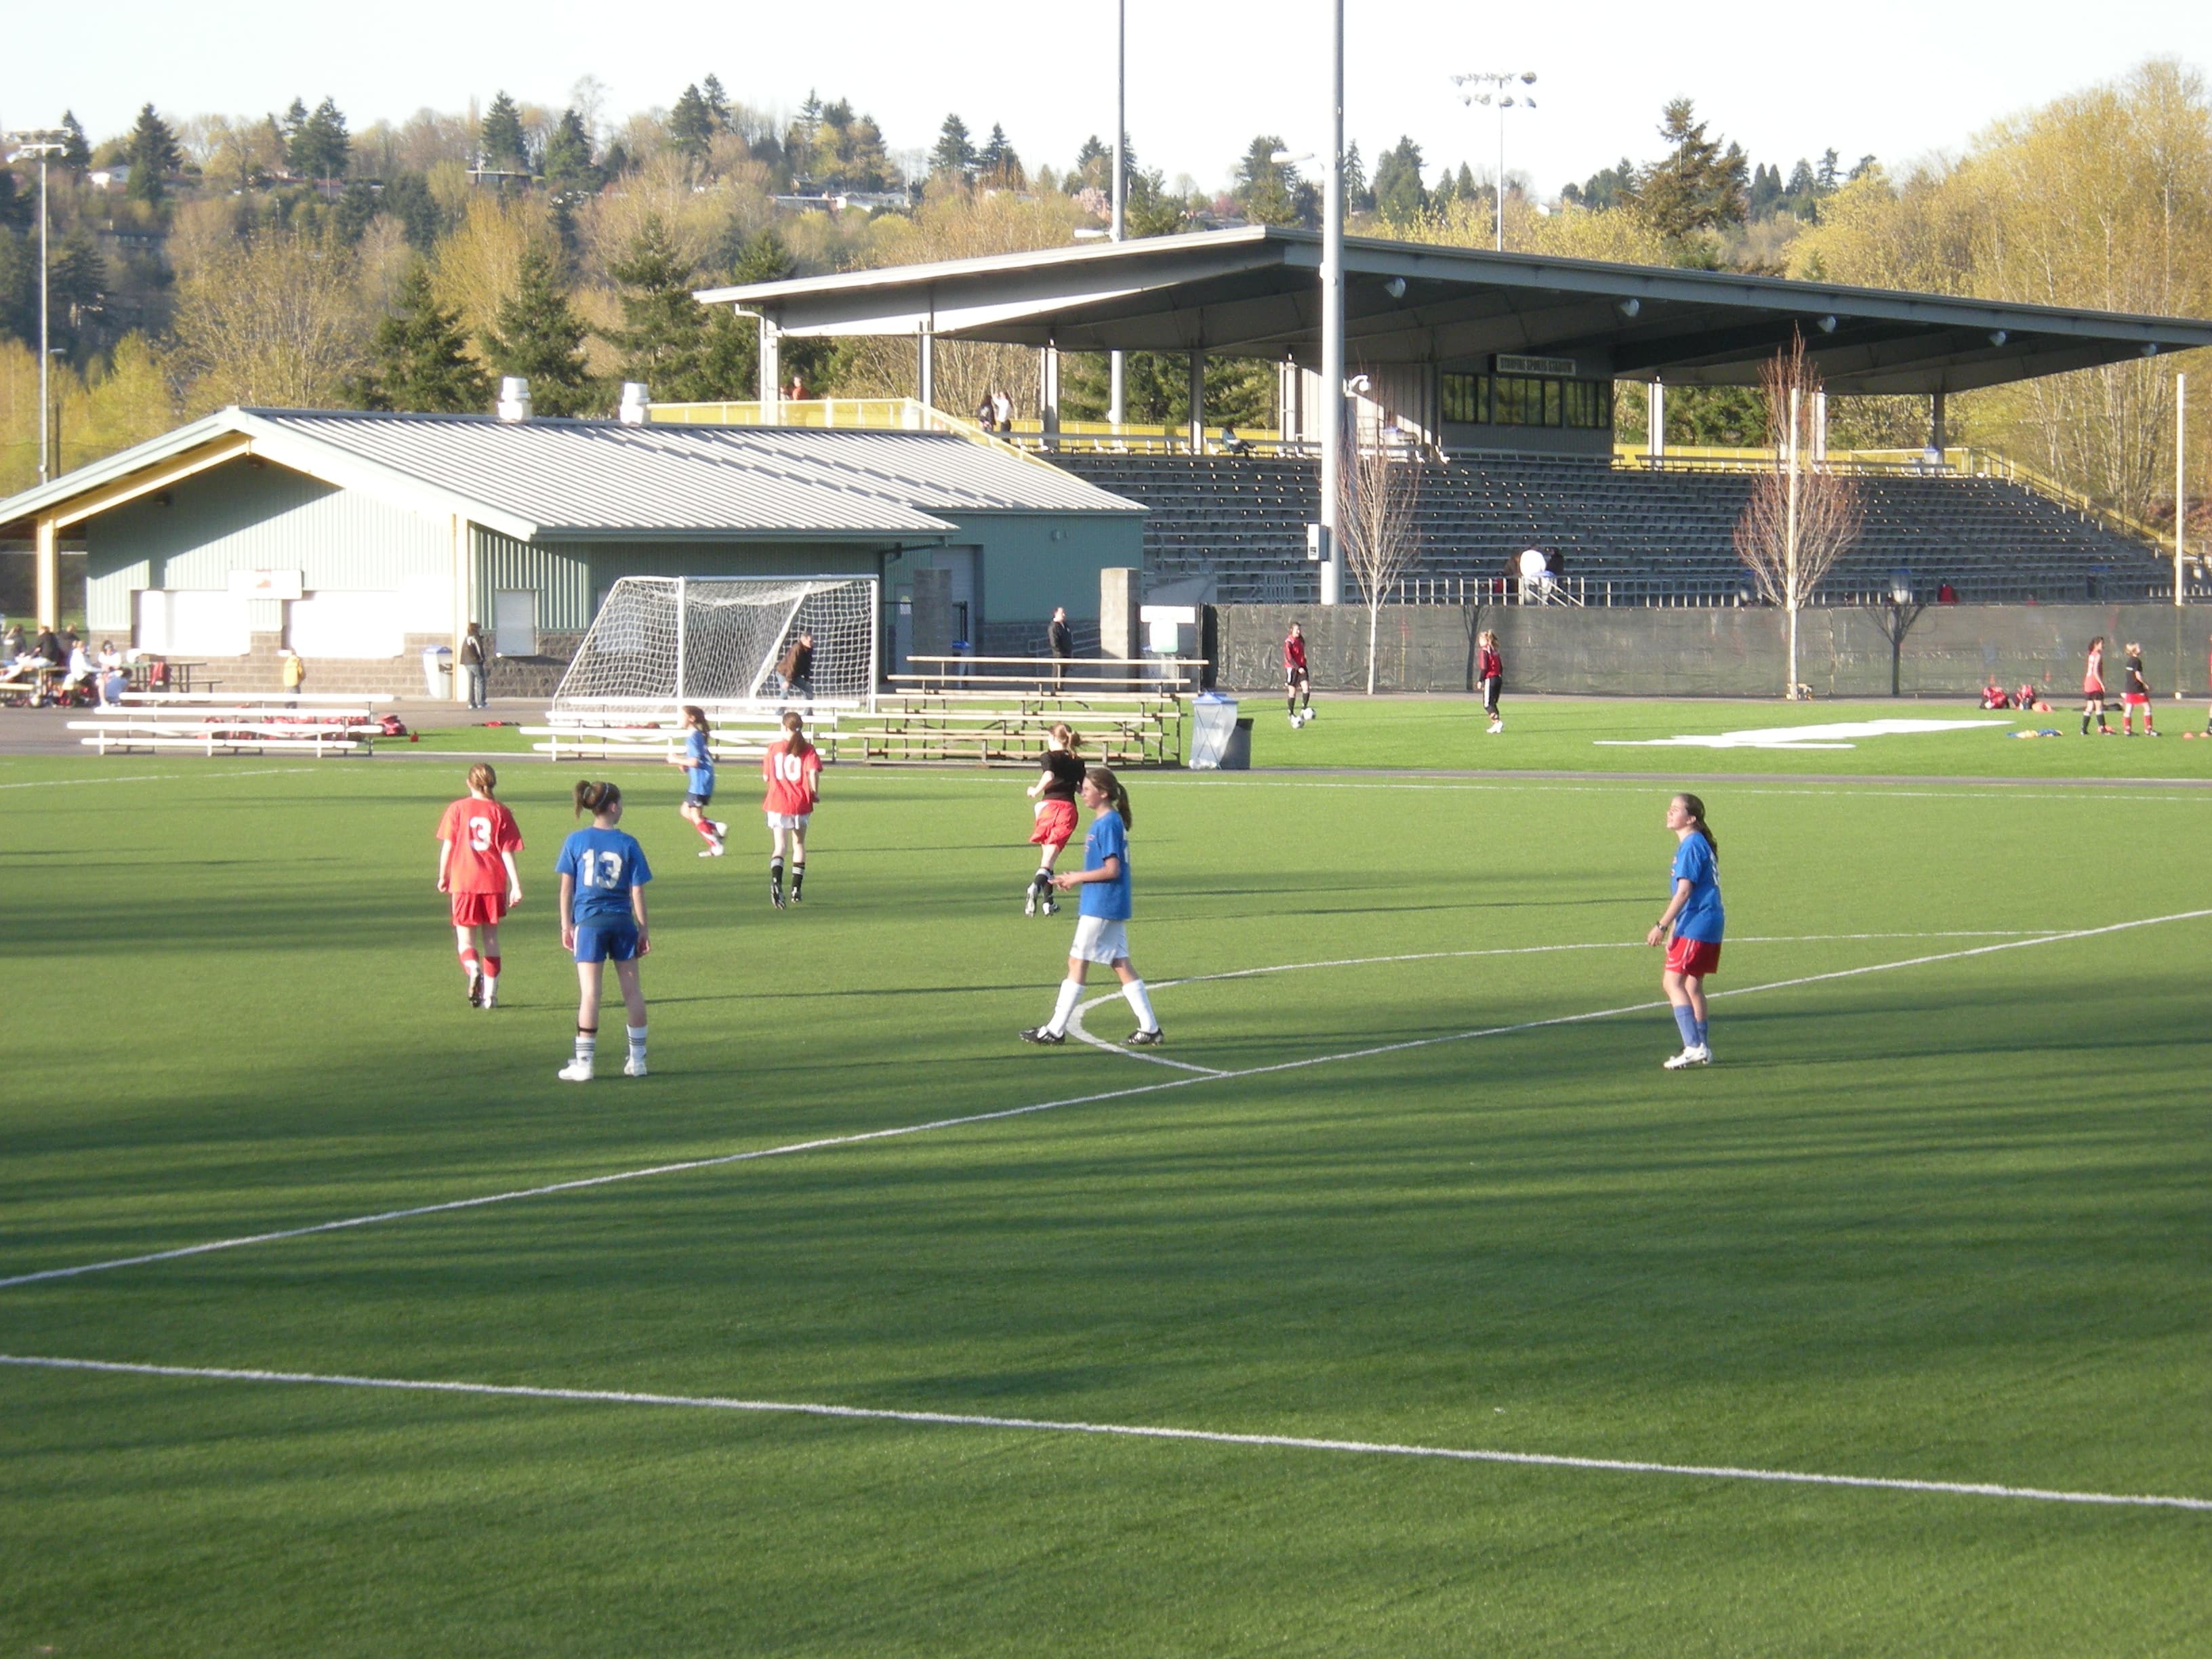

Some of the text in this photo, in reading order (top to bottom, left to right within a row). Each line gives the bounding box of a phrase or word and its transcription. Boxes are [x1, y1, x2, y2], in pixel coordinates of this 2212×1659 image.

[774, 752, 801, 779] 10
[470, 817, 491, 851] 3
[582, 848, 622, 889] 13
